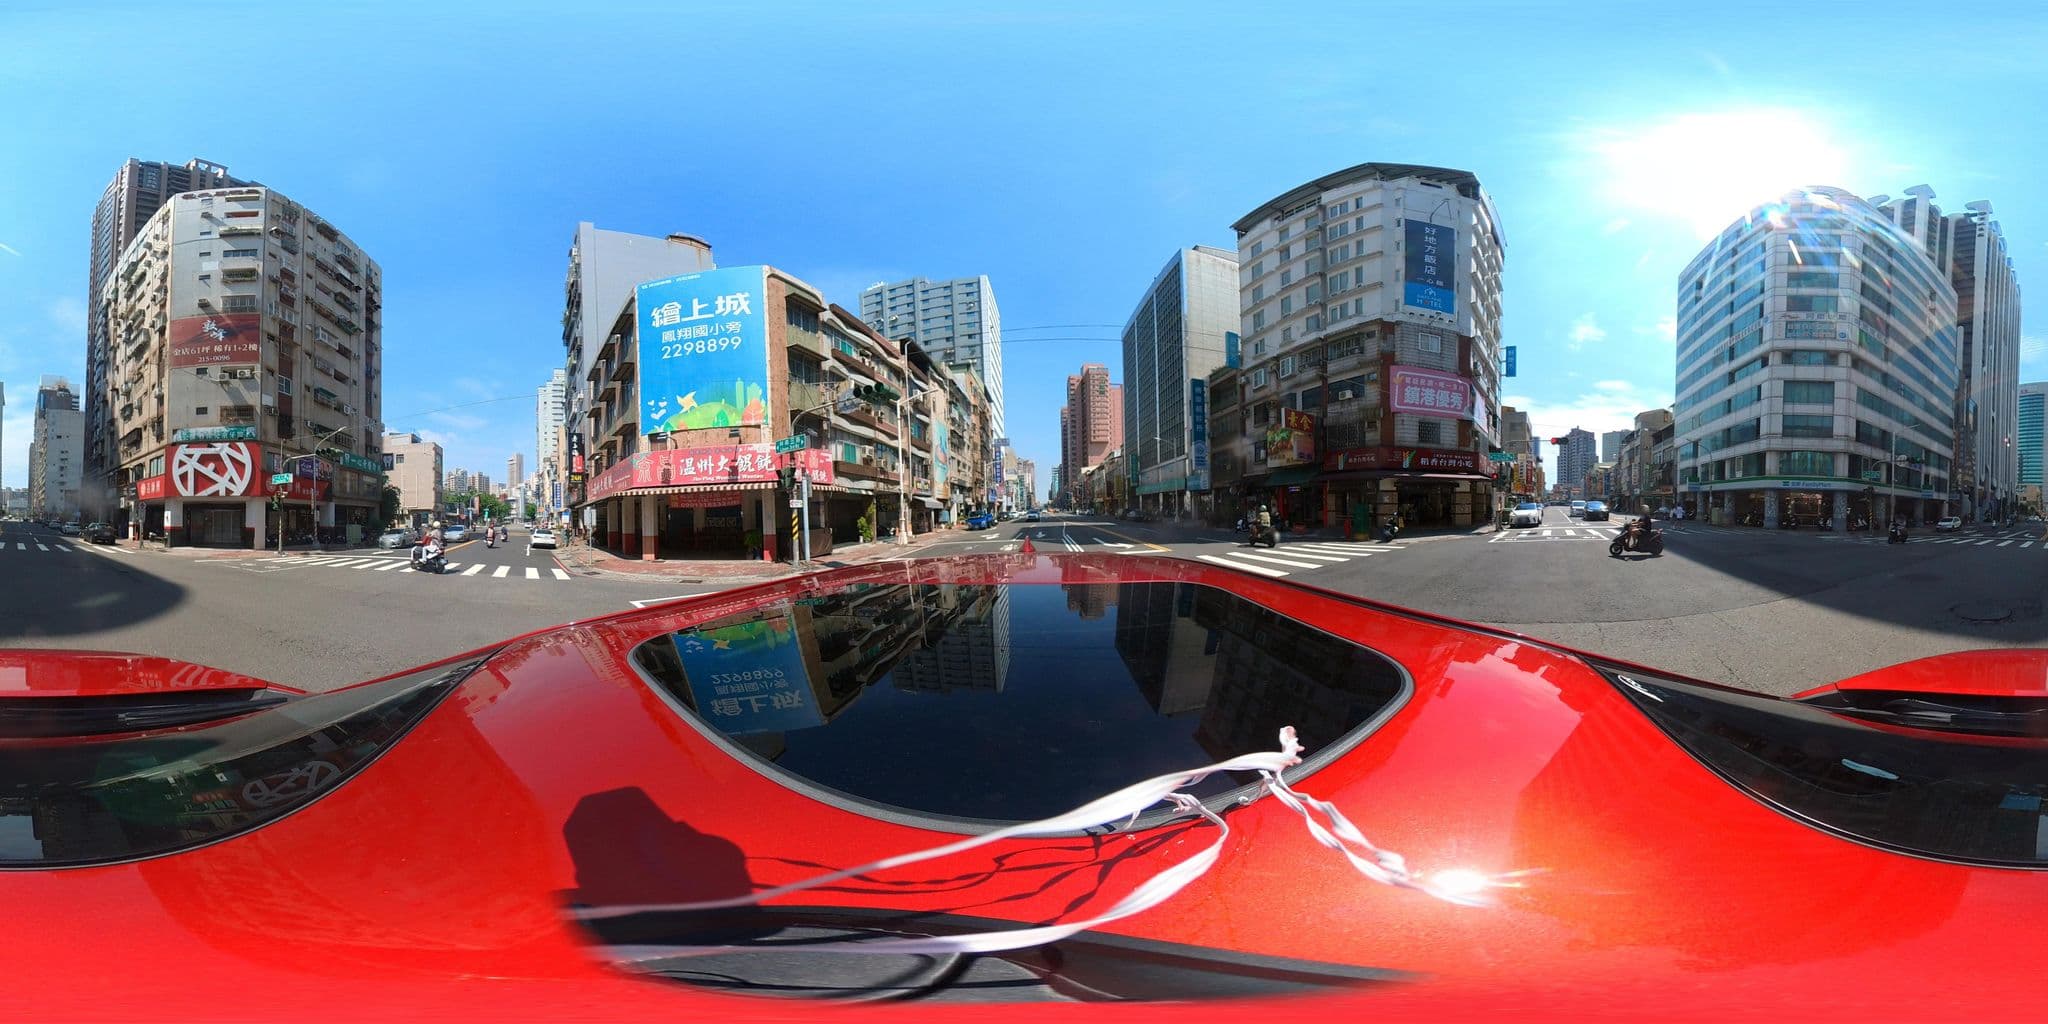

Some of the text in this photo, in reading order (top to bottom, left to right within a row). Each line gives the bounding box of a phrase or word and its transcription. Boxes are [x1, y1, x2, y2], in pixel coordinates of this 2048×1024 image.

[1424, 226, 1438, 276] 好地方飯店
[651, 292, 753, 328] 繪上城
[661, 321, 742, 343] 鳳翔國小旁
[198, 355, 231, 363] 215-0096
[661, 336, 742, 359] 2298899
